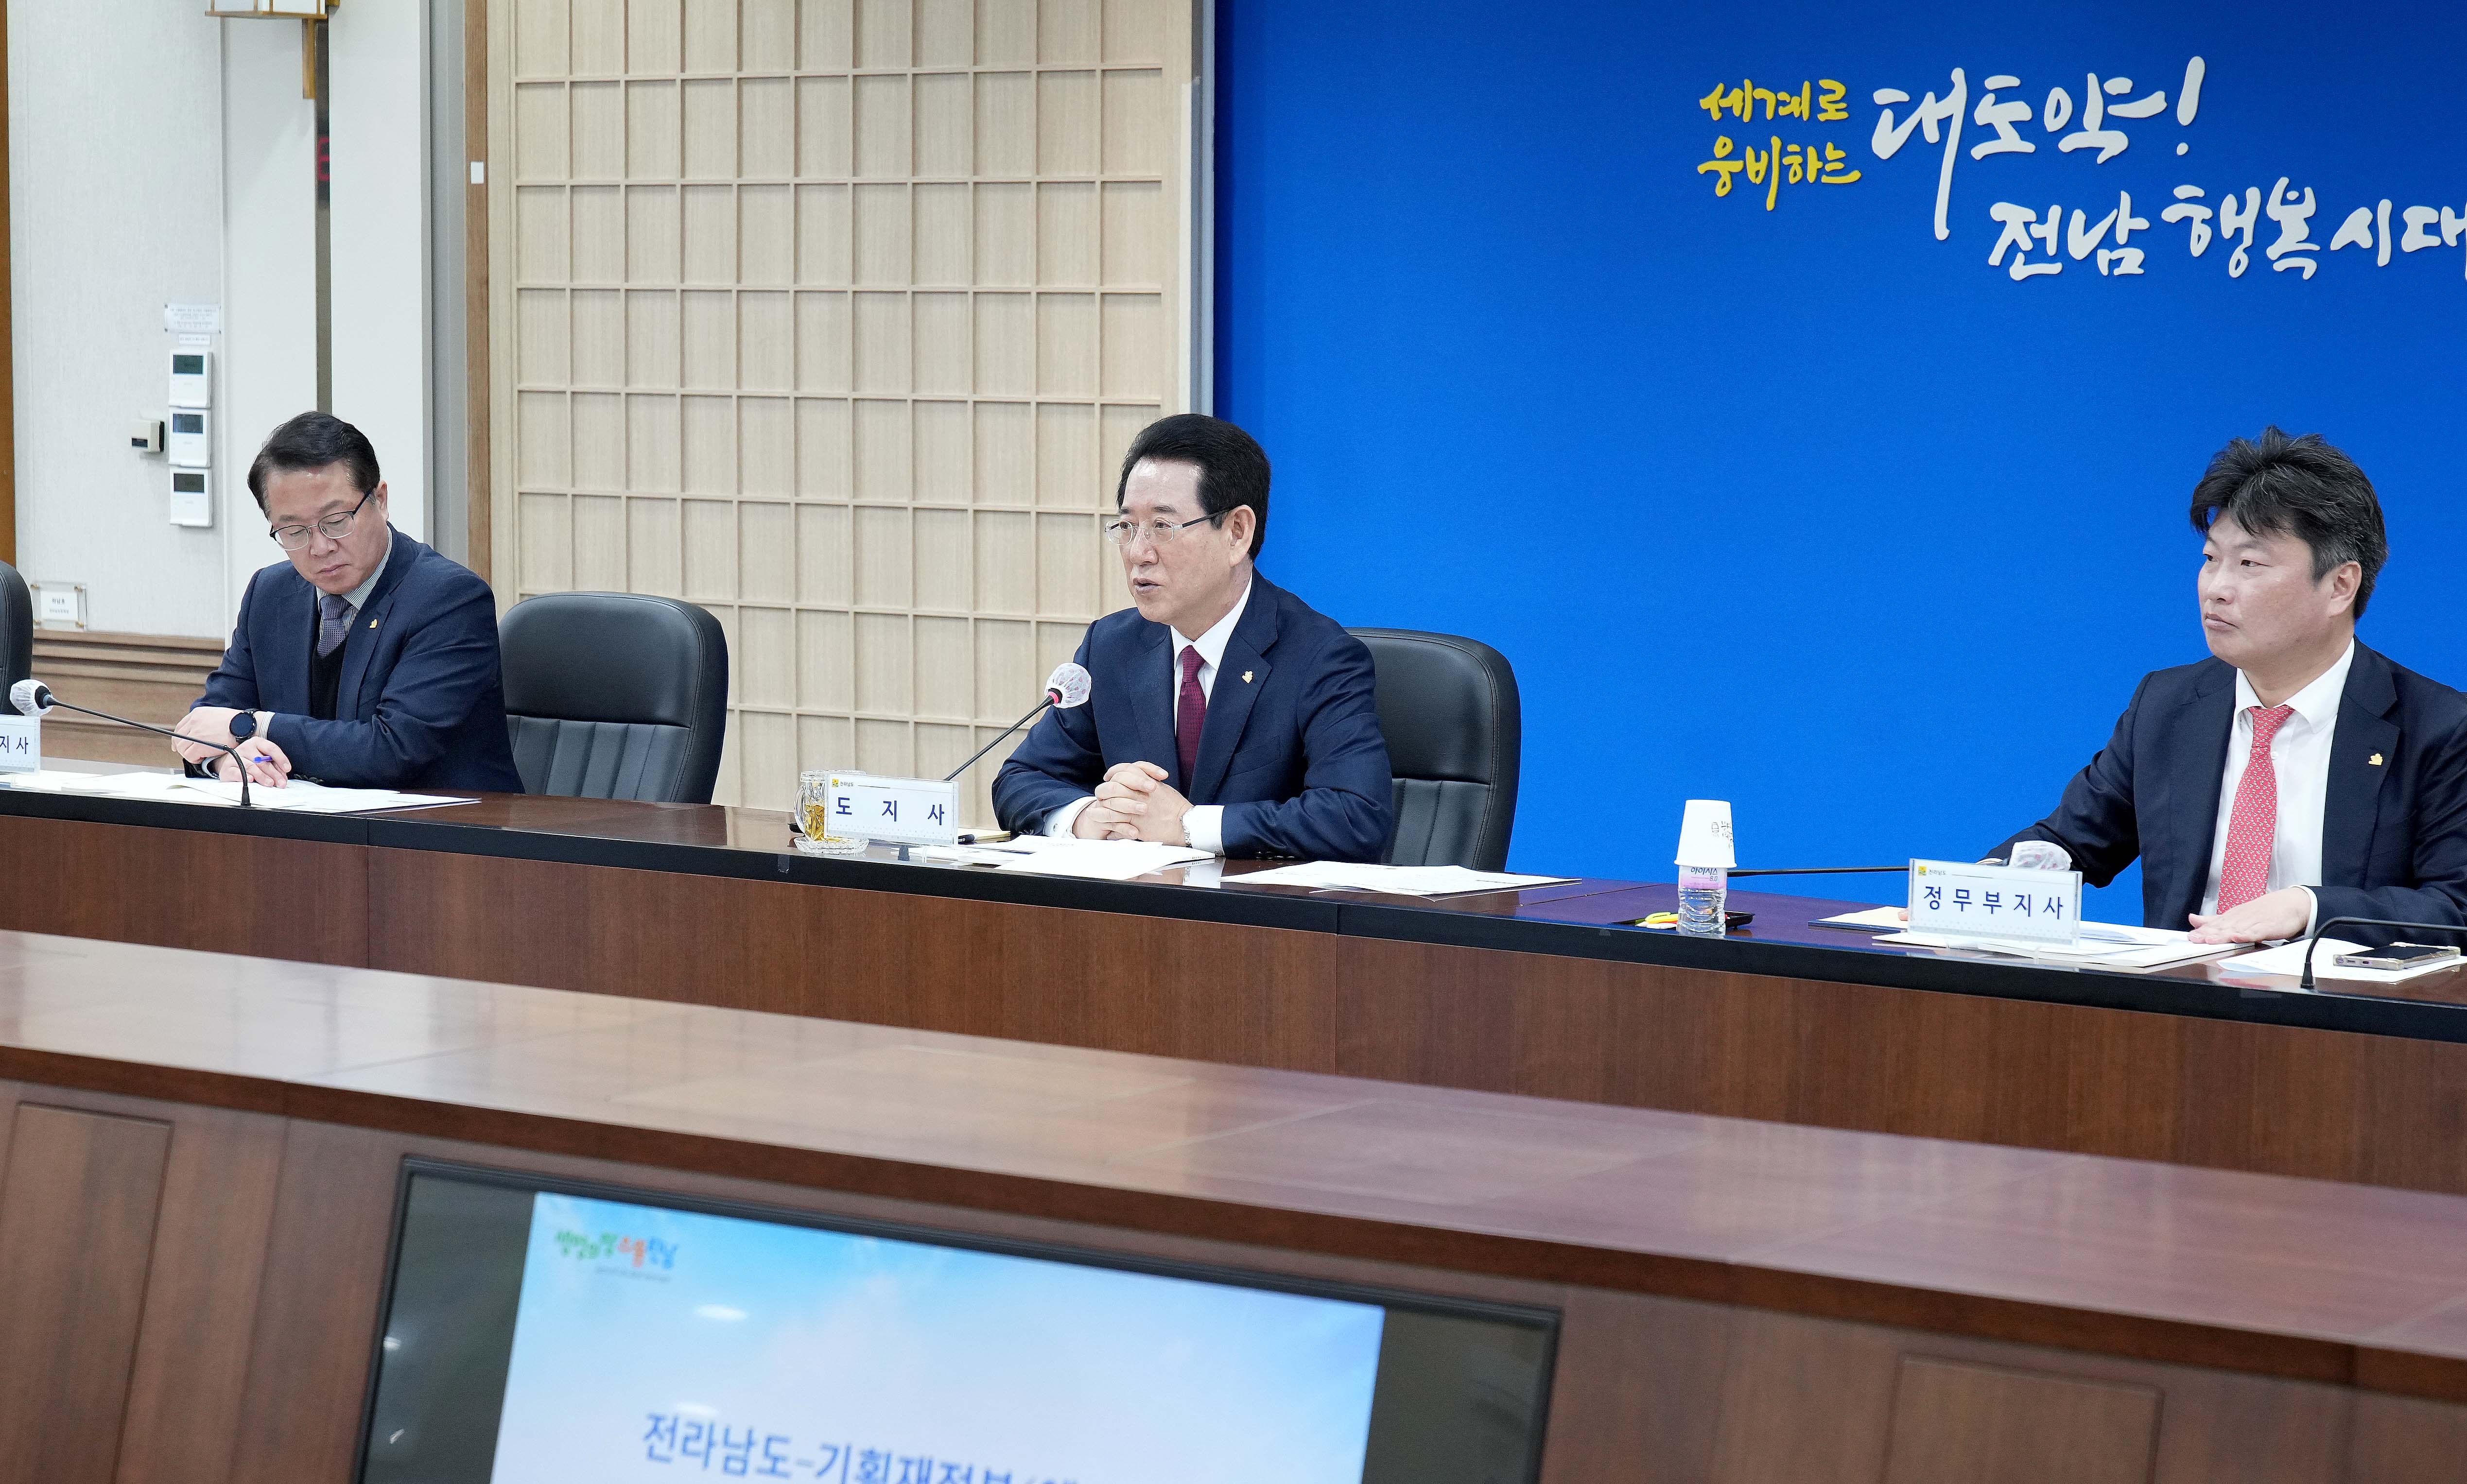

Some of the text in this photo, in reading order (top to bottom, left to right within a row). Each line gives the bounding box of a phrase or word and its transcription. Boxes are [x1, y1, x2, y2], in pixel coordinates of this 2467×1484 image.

[1700, 79, 1849, 123] 세계로
[1698, 136, 1861, 211] 웅비하는
[1872, 56, 2205, 241] 대도약!
[1988, 191, 2150, 281] 전남
[1691, 867, 1718, 875] 아이시스
